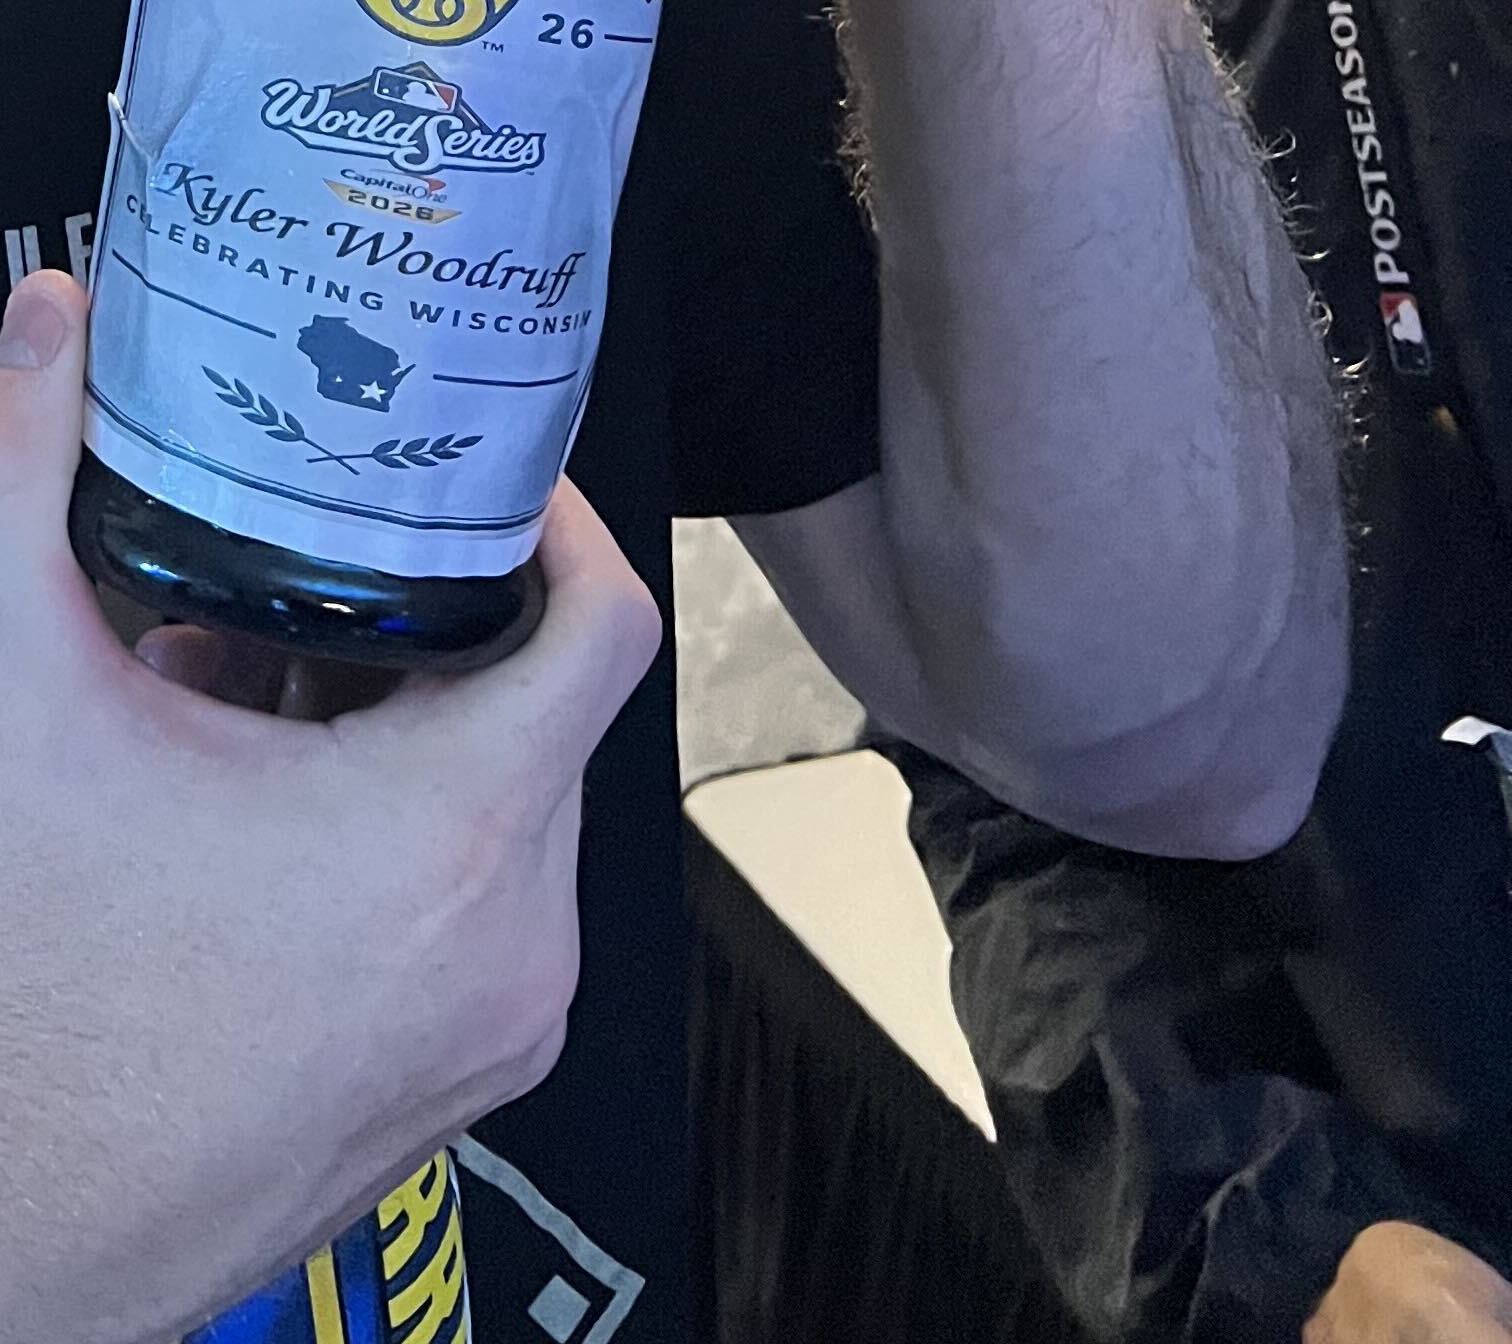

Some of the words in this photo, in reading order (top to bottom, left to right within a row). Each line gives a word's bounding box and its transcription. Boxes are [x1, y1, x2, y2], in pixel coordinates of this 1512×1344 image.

[538, 13, 593, 49] 26
[348, 189, 434, 220] 2026
[155, 162, 310, 240] Kyler
[326, 220, 586, 308] Woodruff
[410, 300, 592, 335] WISCONSIN
